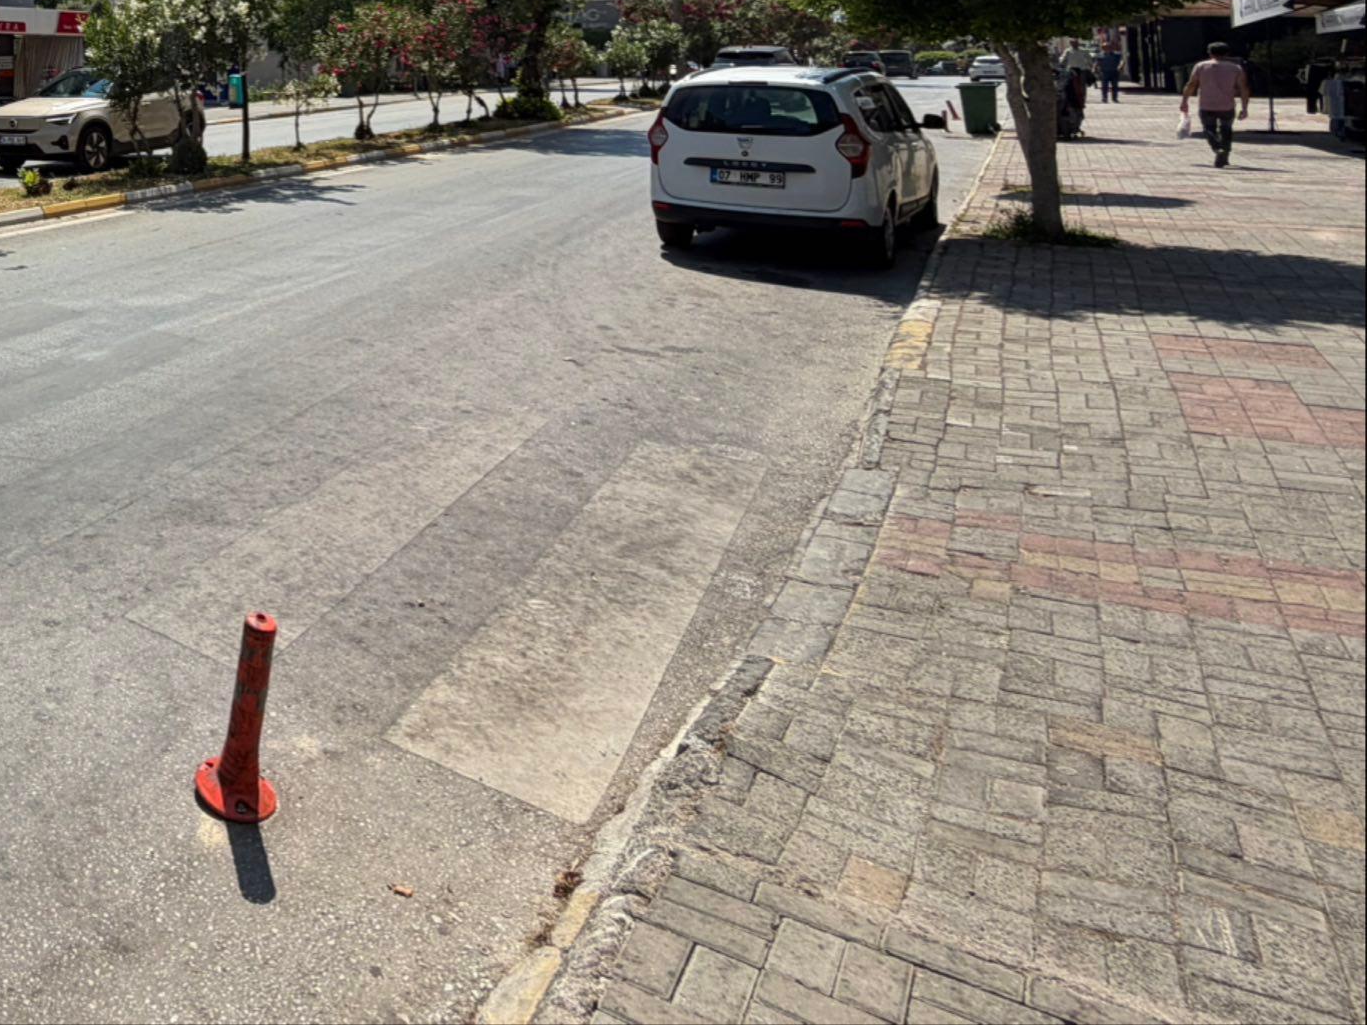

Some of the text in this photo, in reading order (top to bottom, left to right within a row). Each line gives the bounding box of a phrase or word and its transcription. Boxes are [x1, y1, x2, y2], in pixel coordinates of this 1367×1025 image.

[718, 169, 783, 184] 07 HMP 99
